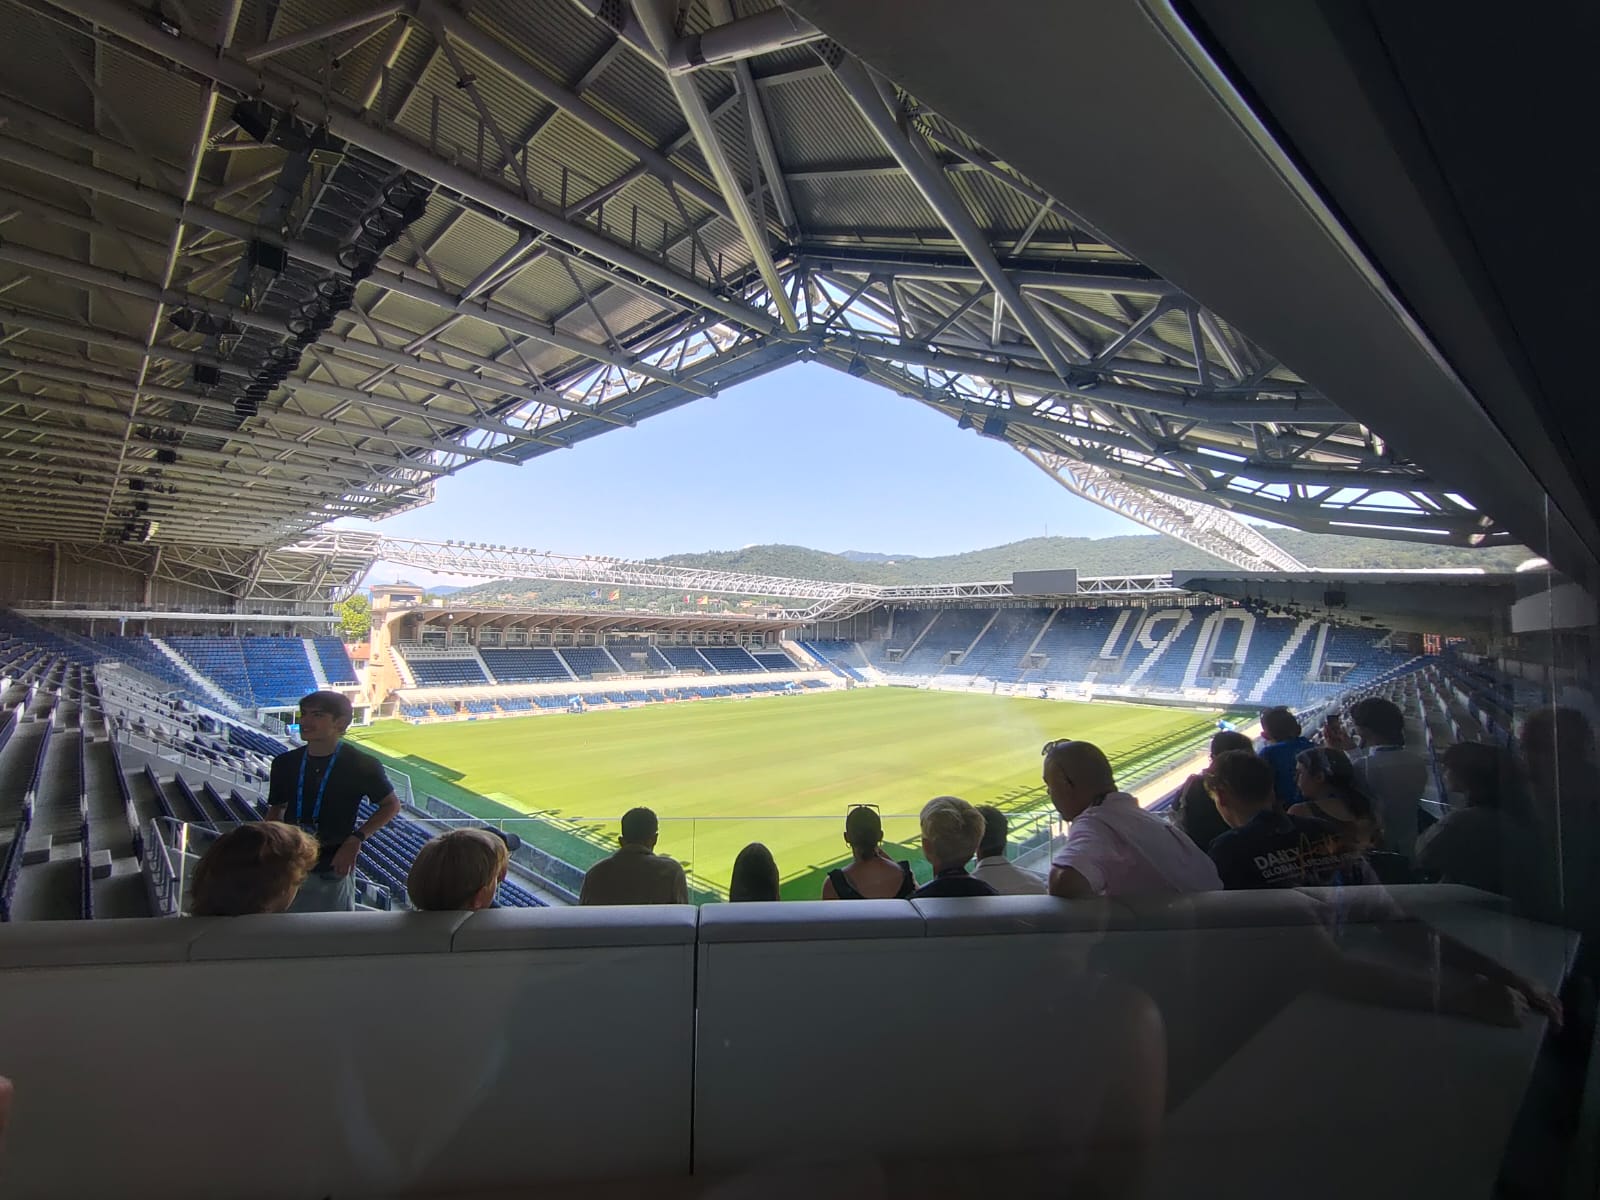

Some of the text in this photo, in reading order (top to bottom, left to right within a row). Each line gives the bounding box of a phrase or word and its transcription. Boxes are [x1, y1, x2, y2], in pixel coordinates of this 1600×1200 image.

[1083, 607, 1318, 702] 1907
[1253, 847, 1300, 870] DAILY
[1262, 862, 1302, 879] GLOBAL
